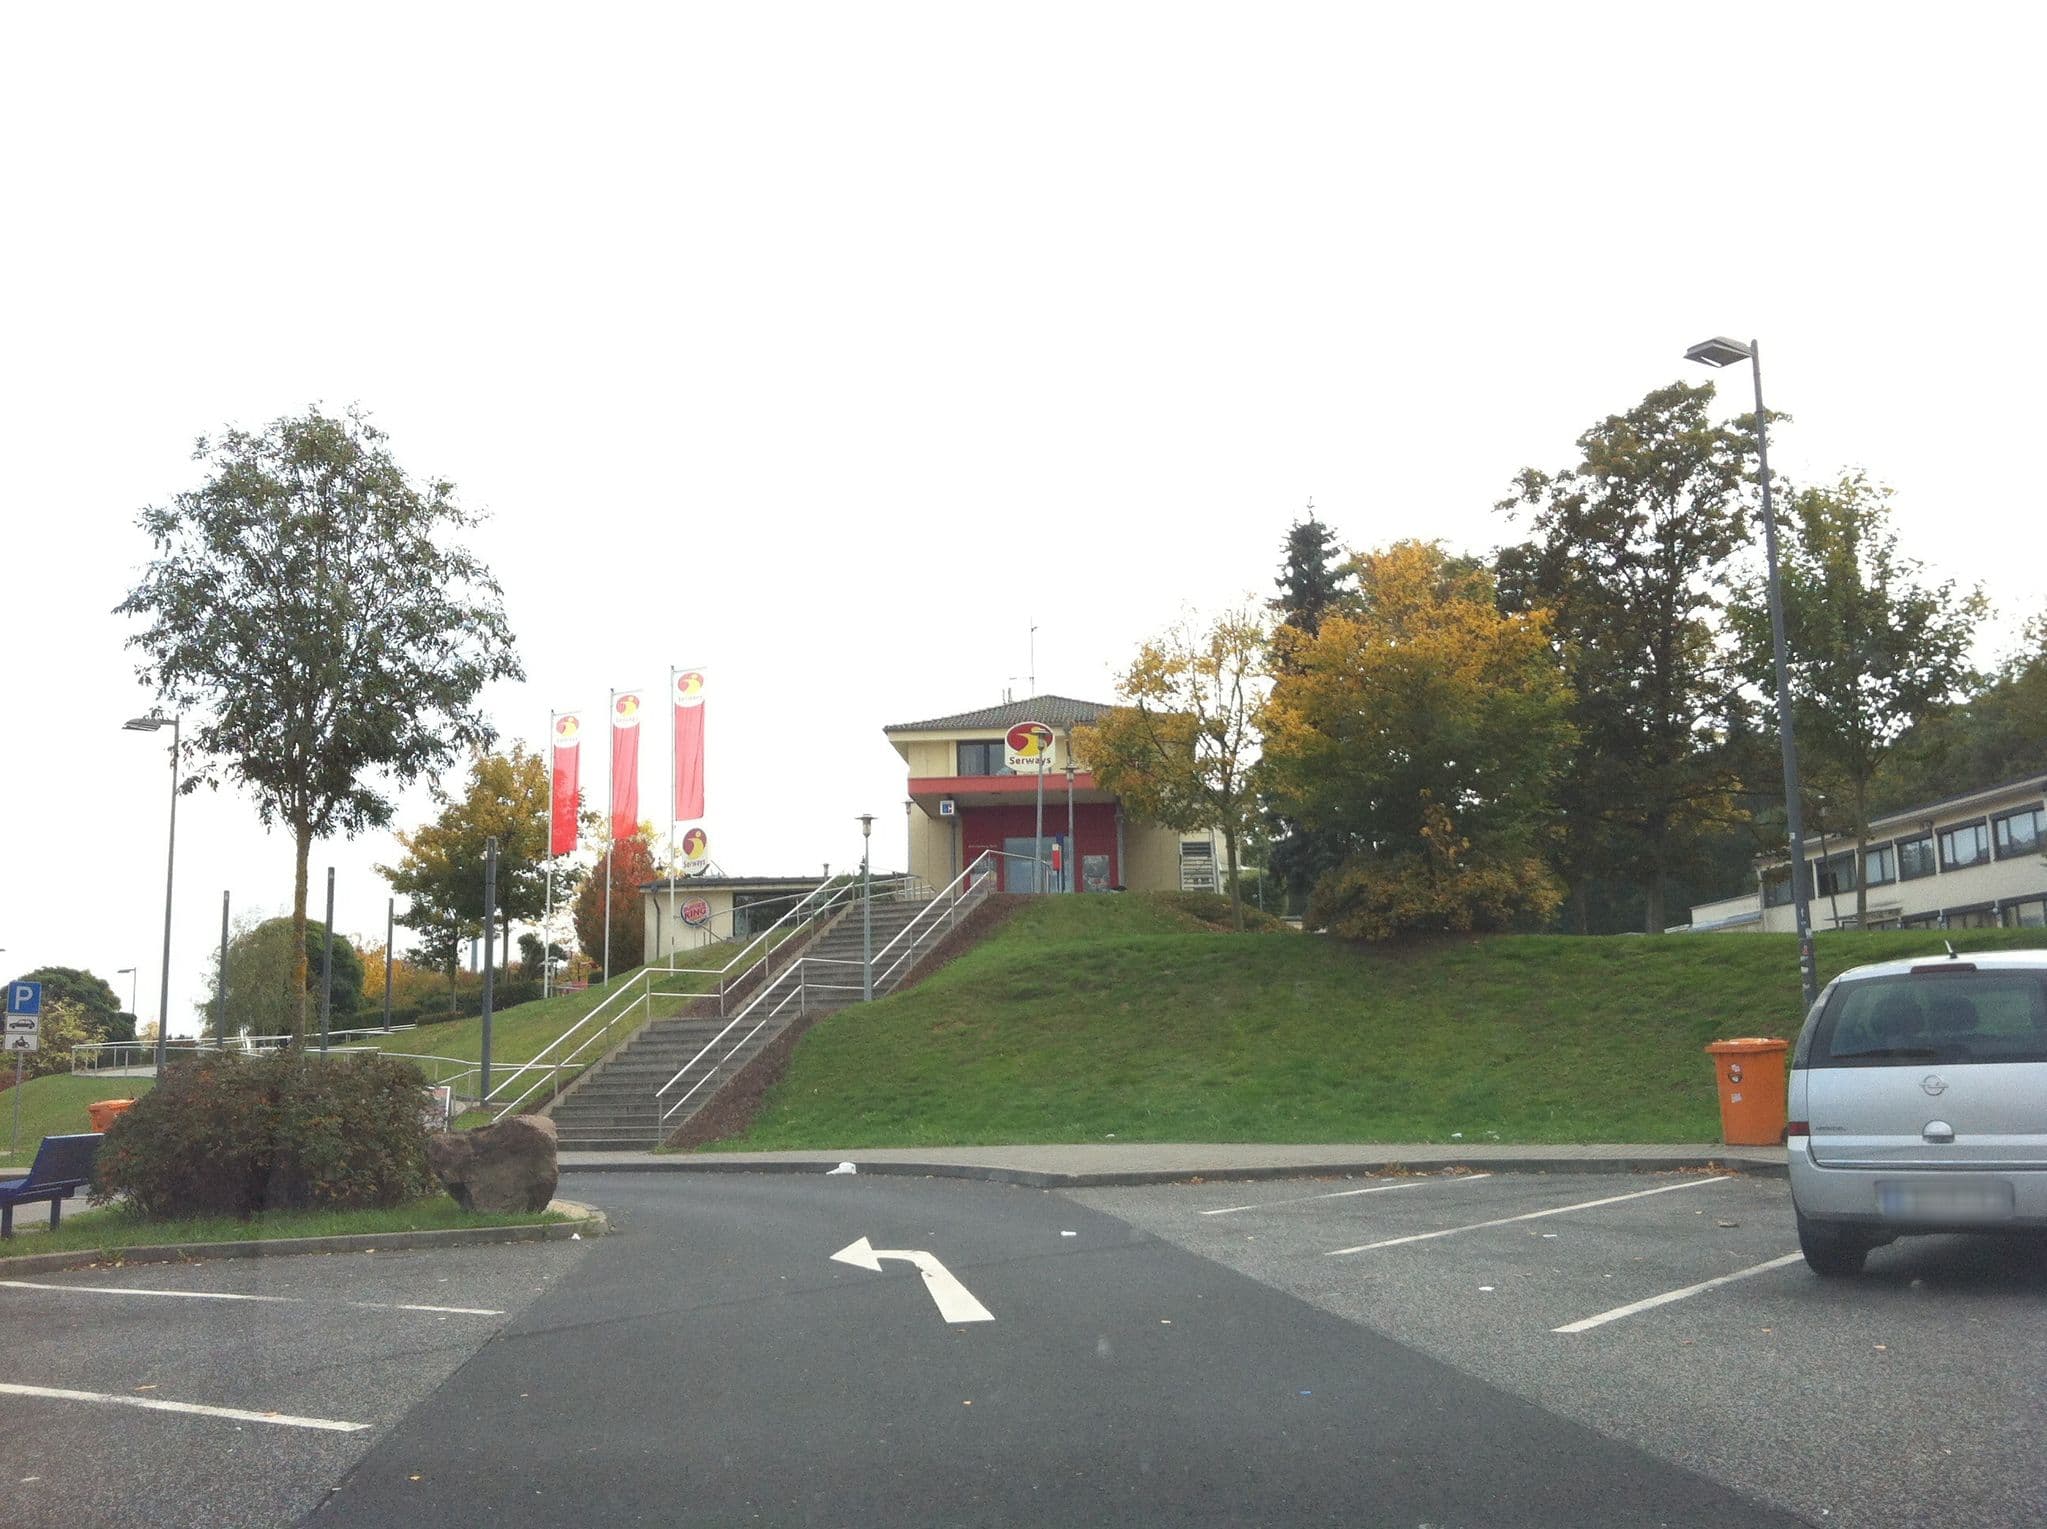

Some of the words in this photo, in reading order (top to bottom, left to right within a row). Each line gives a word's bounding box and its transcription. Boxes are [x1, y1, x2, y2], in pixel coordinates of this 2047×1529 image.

[1009, 756, 1051, 767] Serways
[684, 908, 706, 919] KING
[15, 986, 33, 1010] P
